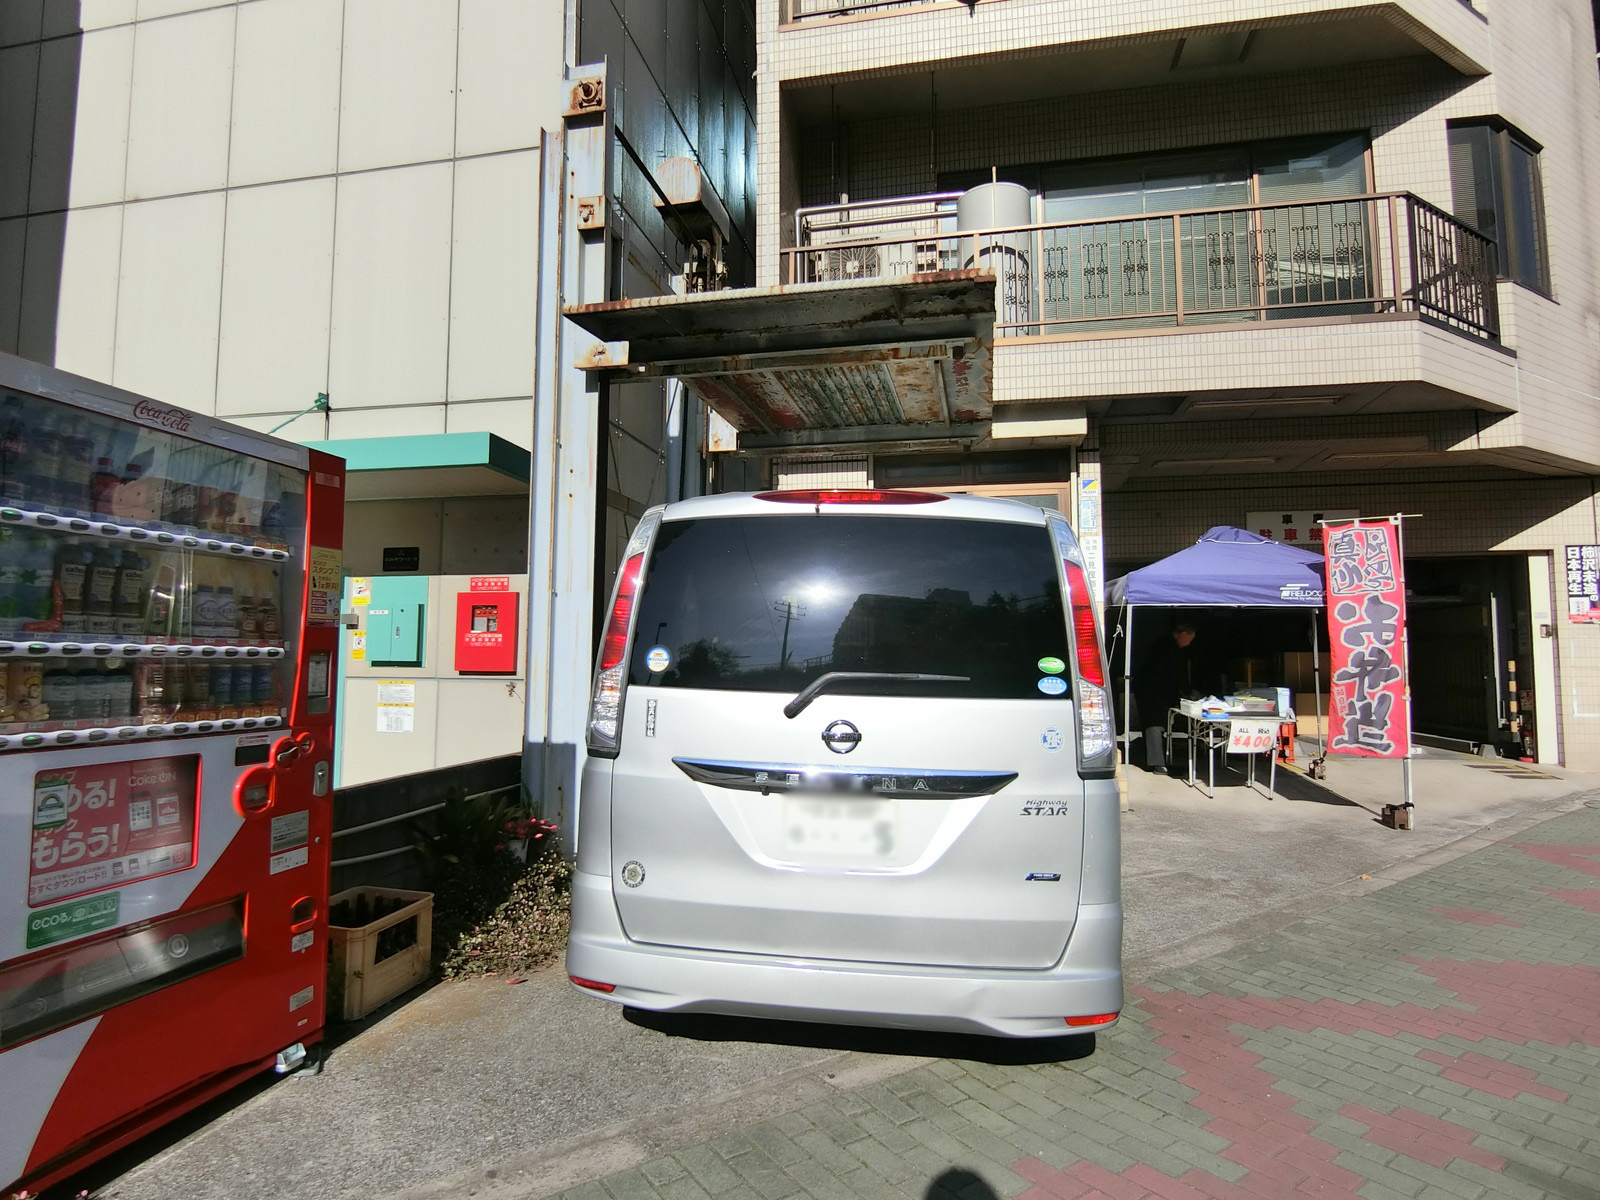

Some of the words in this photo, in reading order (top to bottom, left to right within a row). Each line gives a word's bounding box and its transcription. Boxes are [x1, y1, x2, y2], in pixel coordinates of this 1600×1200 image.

[1567, 546, 1582, 595] 日本再生
[1233, 735, 1272, 748] ¥400
[128, 775, 157, 787] Coke
[1025, 799, 1068, 807] Highway
[1020, 807, 1068, 816] STAR
[32, 823, 120, 869] もらう!
